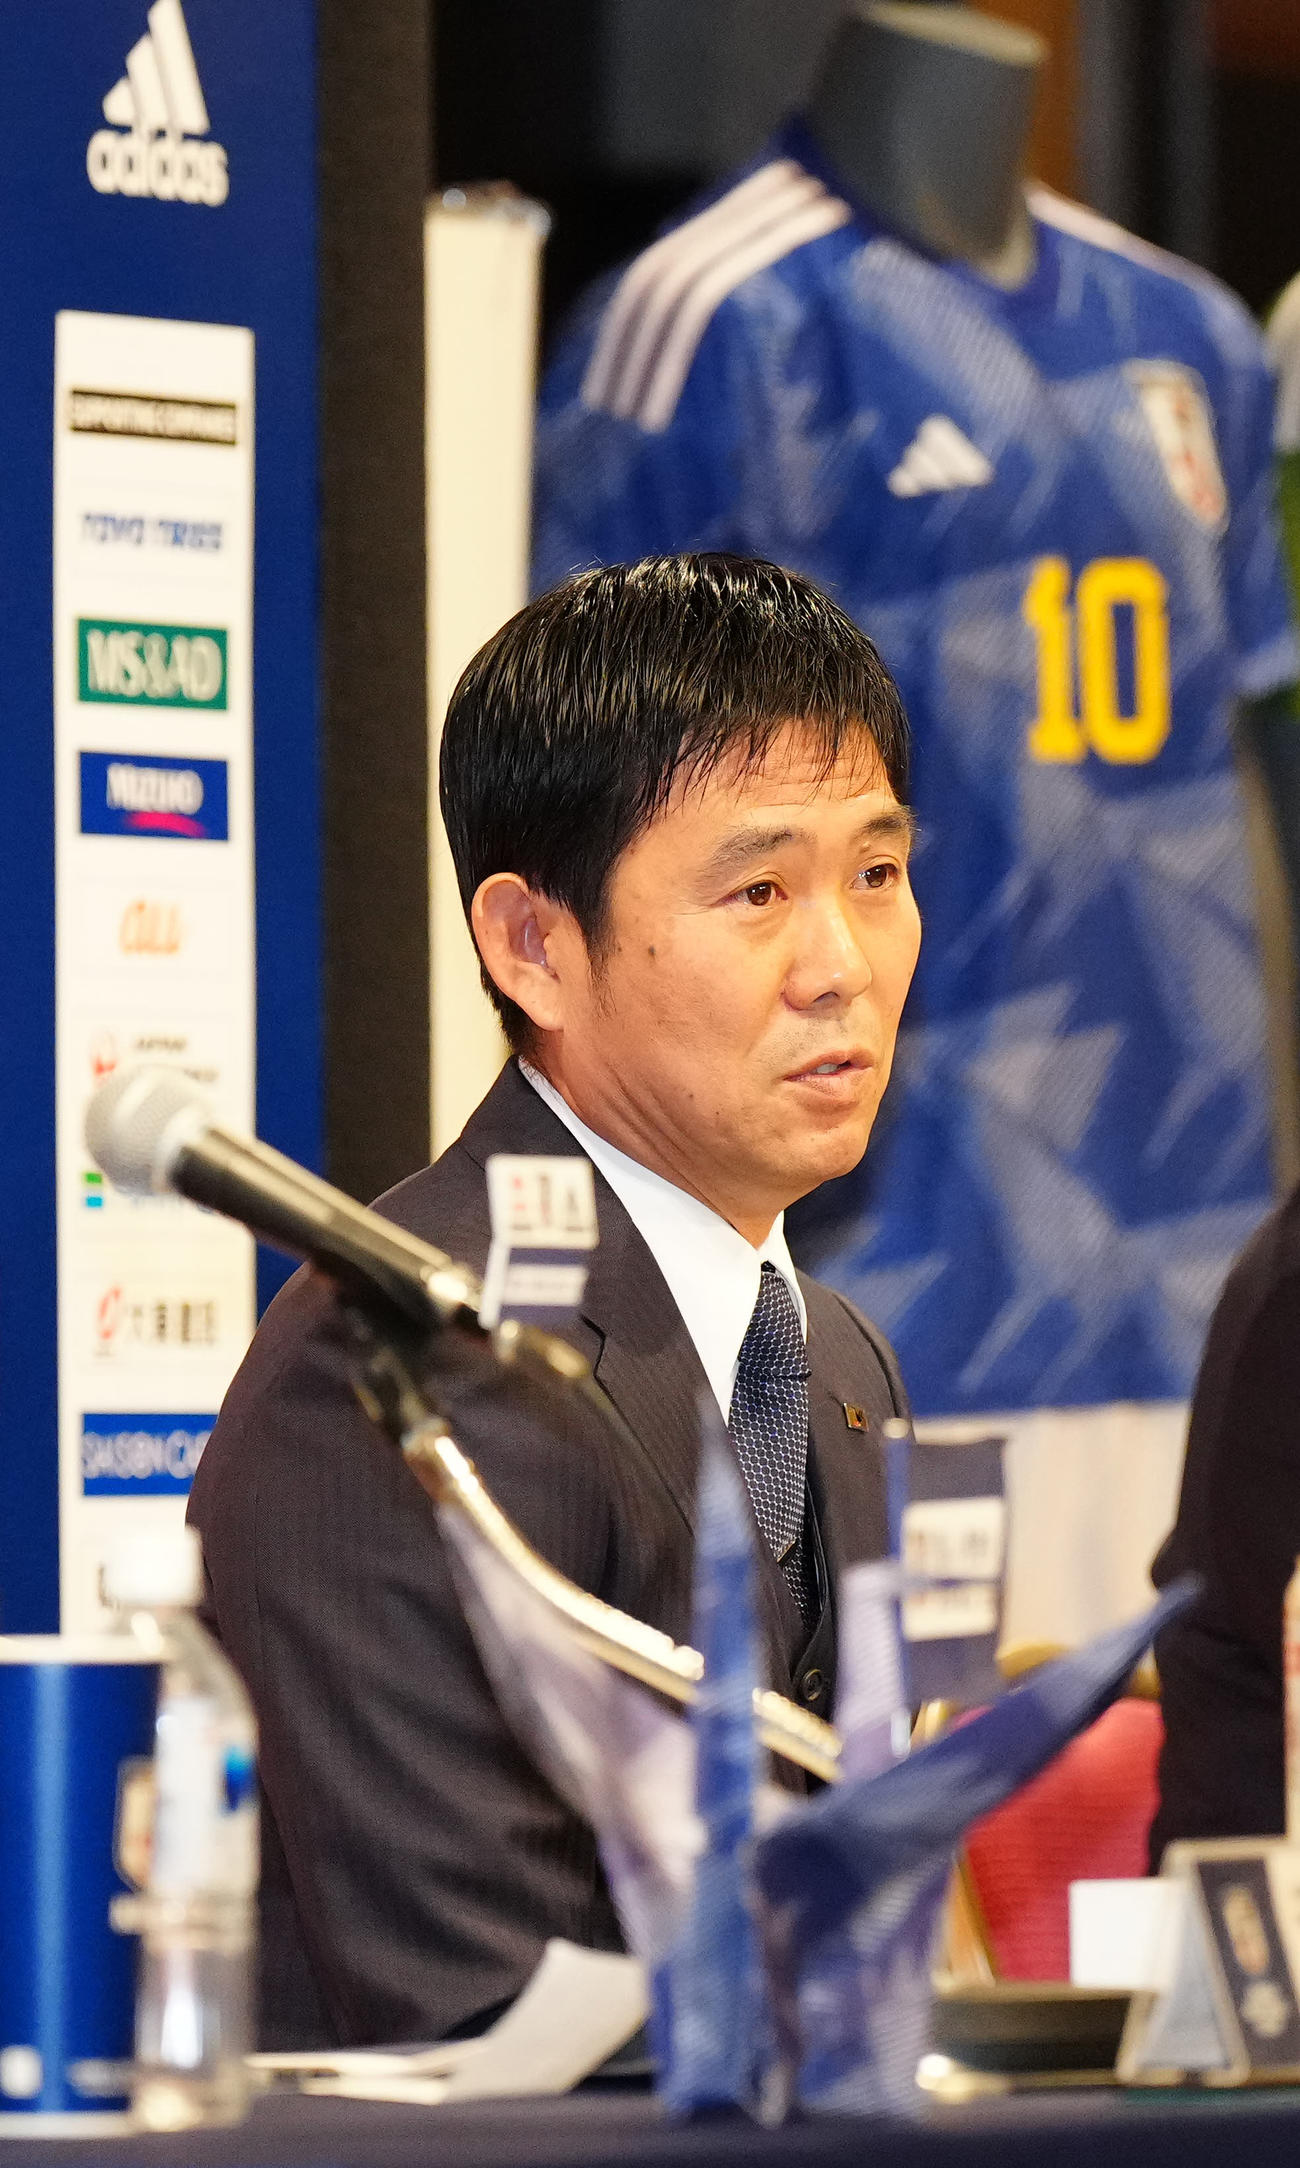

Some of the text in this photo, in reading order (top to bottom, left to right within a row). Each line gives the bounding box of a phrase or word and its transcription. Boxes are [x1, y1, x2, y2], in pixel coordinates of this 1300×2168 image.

[86, 122, 229, 207] adidas
[86, 628, 223, 702] MS&AD
[1022, 553, 1172, 765] 10
